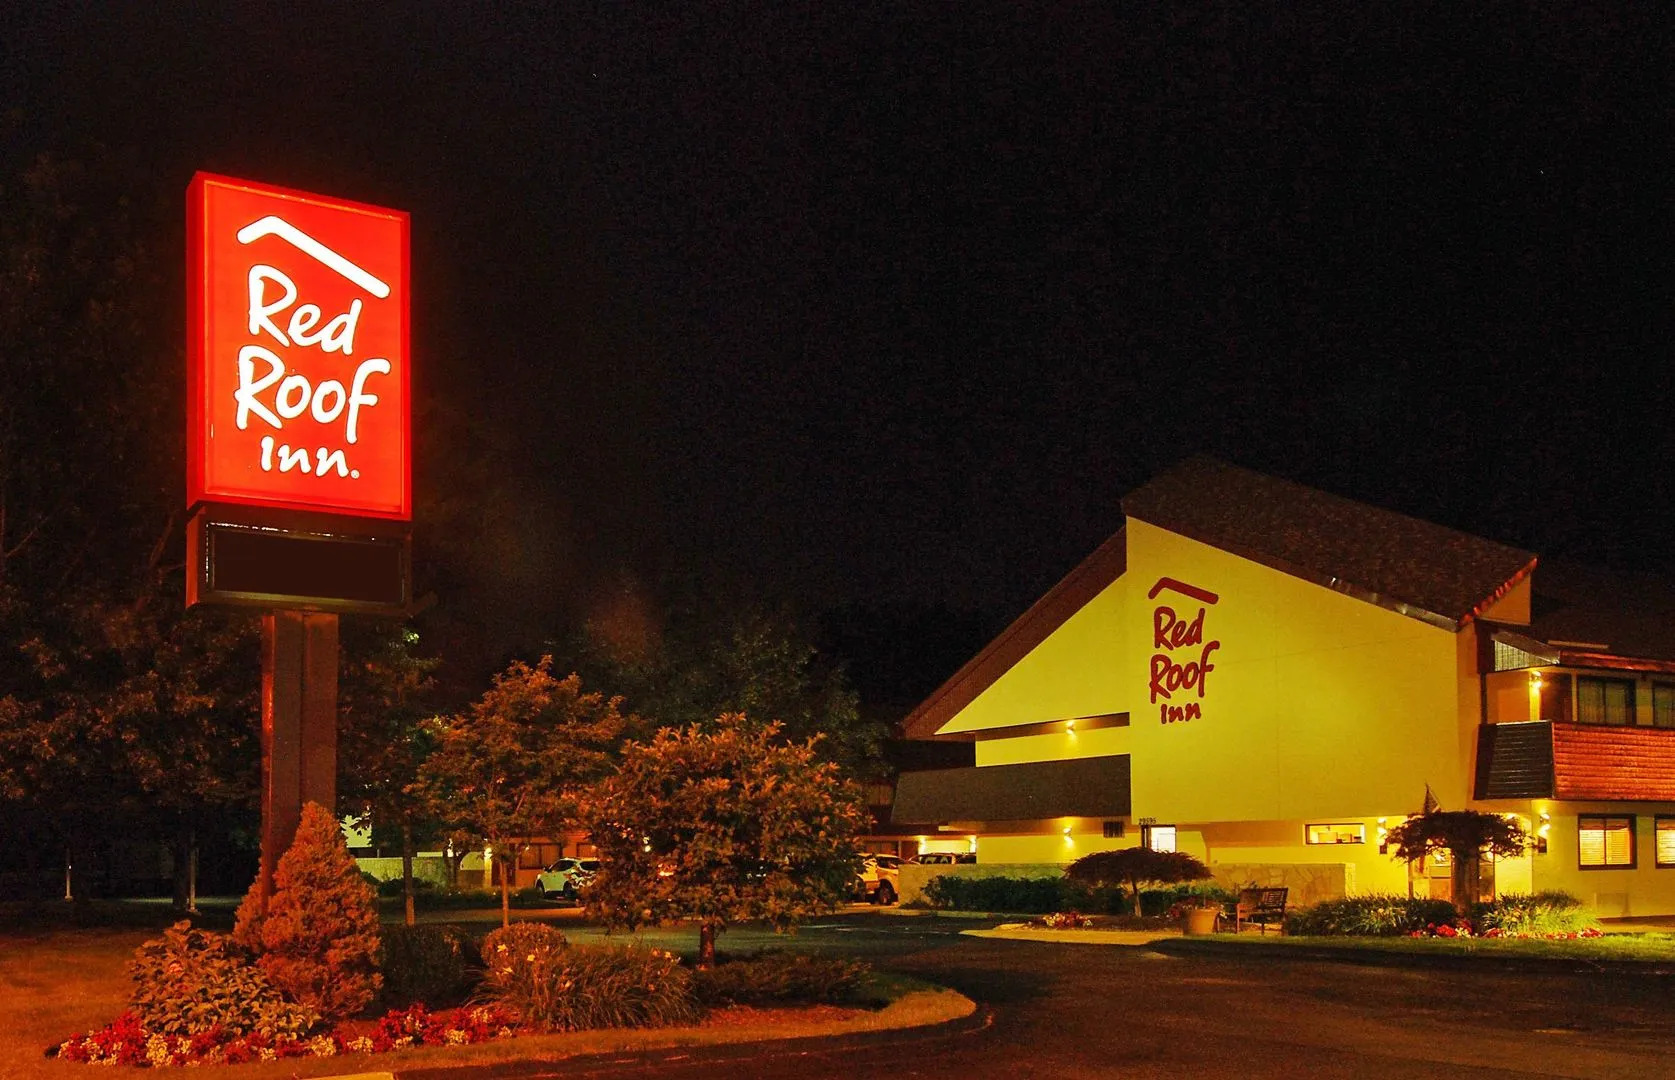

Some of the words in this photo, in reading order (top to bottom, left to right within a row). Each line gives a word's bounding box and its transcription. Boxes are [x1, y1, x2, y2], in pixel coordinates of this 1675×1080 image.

[248, 264, 362, 355] Red
[234, 344, 391, 444] Roof
[1154, 606, 1205, 650] Red
[1149, 641, 1220, 704] Roof
[1161, 703, 1201, 724] Inn
